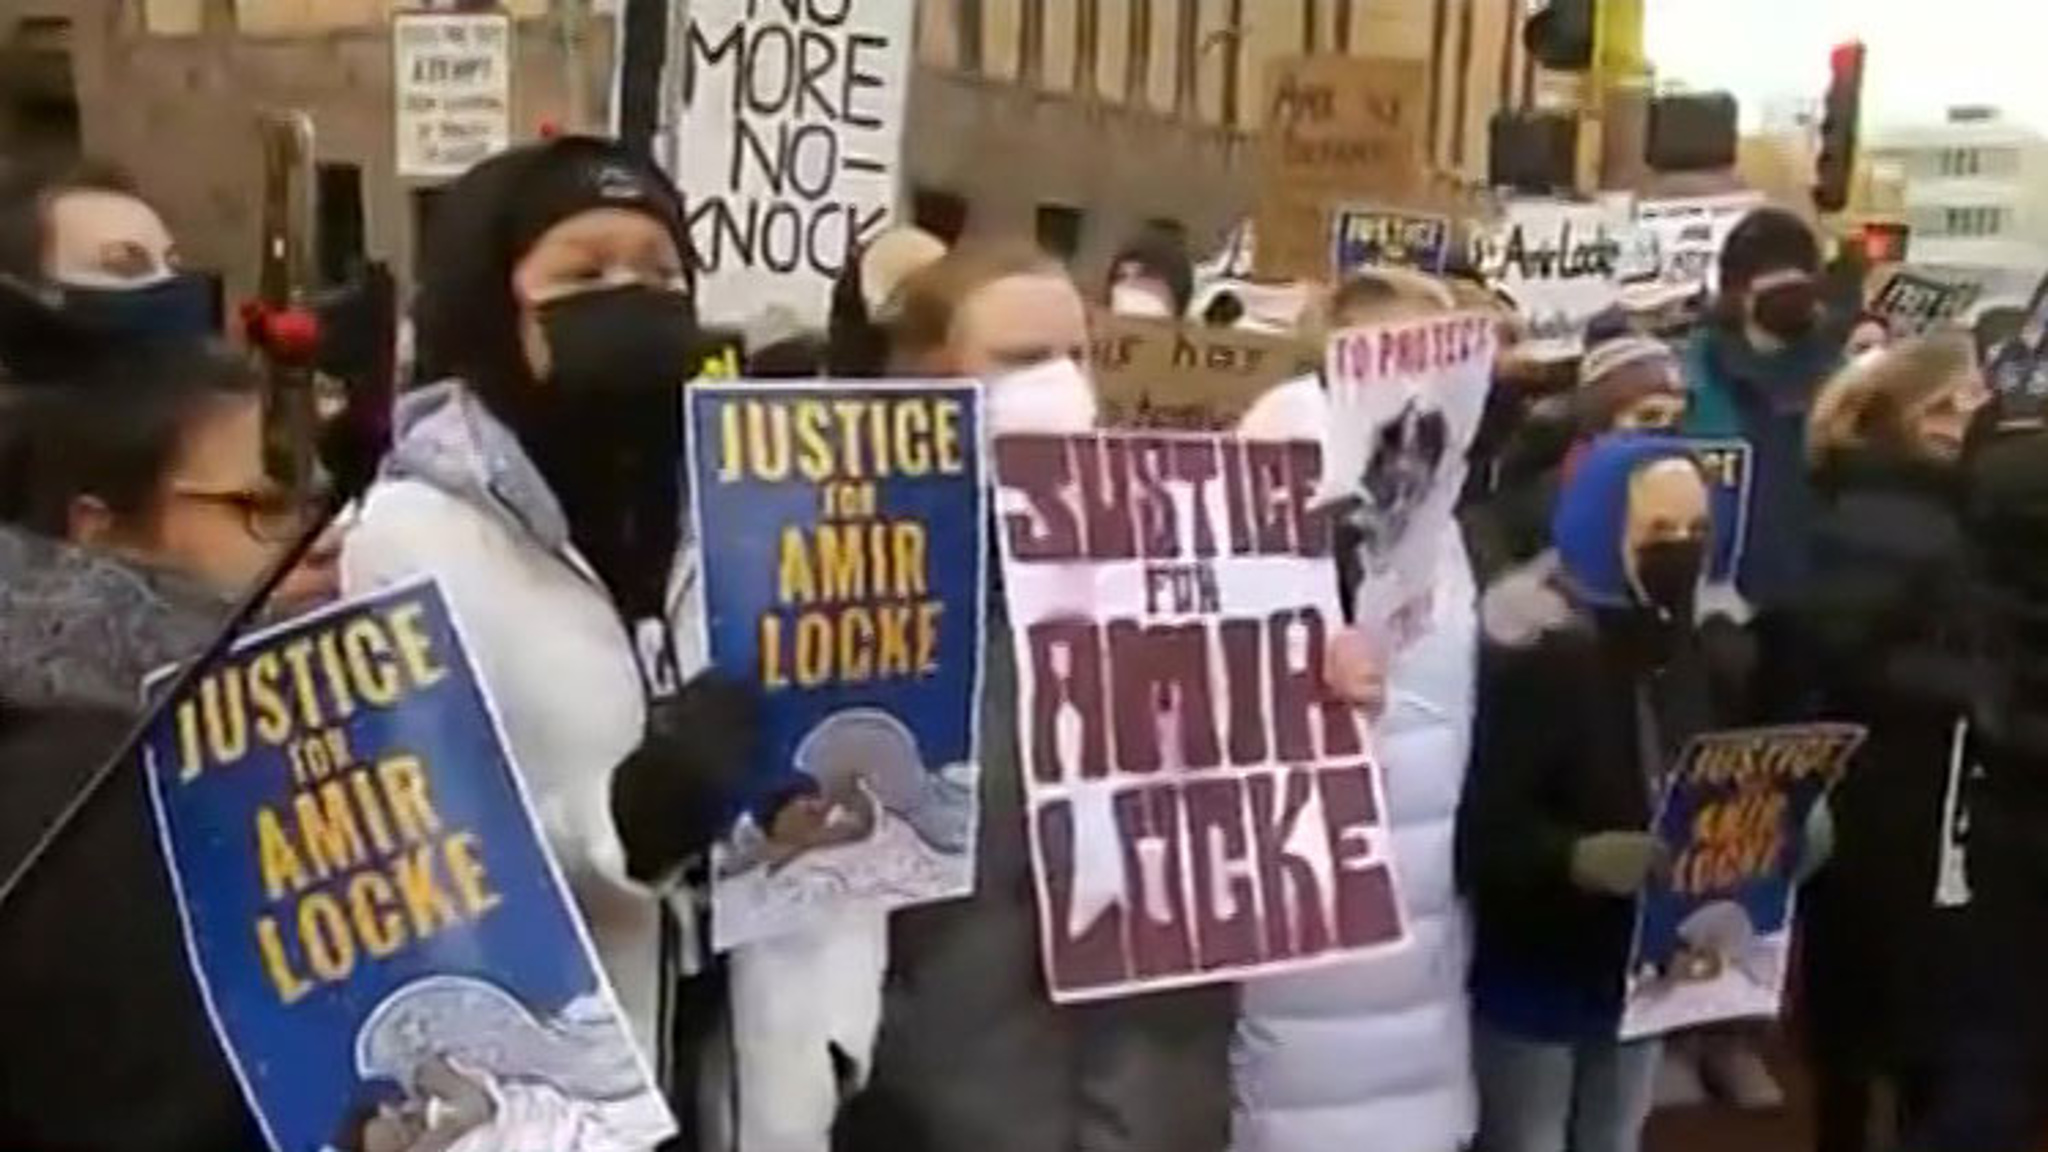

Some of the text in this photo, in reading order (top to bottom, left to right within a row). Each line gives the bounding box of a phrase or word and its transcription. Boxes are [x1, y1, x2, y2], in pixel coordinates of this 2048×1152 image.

[682, 17, 889, 129] MORE
[730, 117, 886, 201] NO-
[718, 396, 963, 484] JUSTICE
[822, 480, 876, 519] FOR
[994, 434, 1334, 562] JUSTICE
[778, 519, 928, 605] AMIR
[1146, 565, 1220, 617] FOR
[175, 601, 450, 784] JUSTICE
[761, 601, 944, 691] LOCKE
[1027, 608, 1362, 780] AMIR
[287, 727, 351, 782] FOR
[257, 757, 439, 899] AMIR
[1037, 764, 1402, 988] LOCKE
[257, 833, 501, 1003] LOCKE
